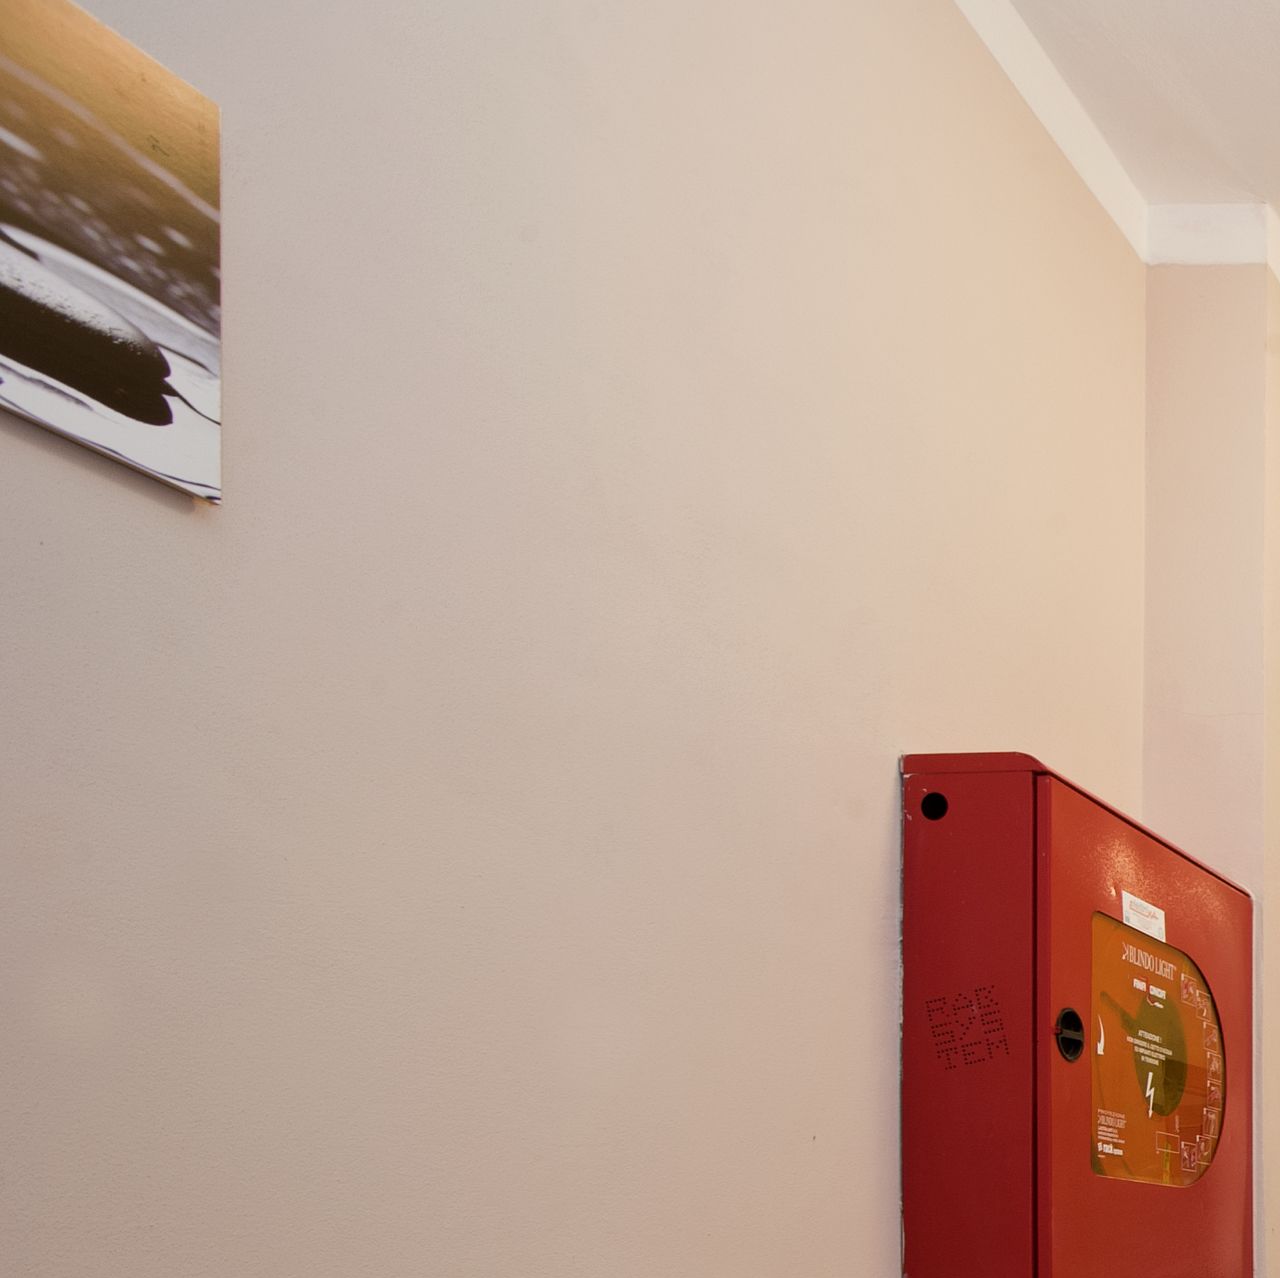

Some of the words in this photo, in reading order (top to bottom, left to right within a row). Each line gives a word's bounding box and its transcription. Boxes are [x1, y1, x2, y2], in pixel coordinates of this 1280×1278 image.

[1129, 943, 1155, 972] BLINDO
[1155, 956, 1177, 981] LIGHT
[930, 1009, 1004, 1047] SYS
[936, 1034, 1010, 1071] TEM
